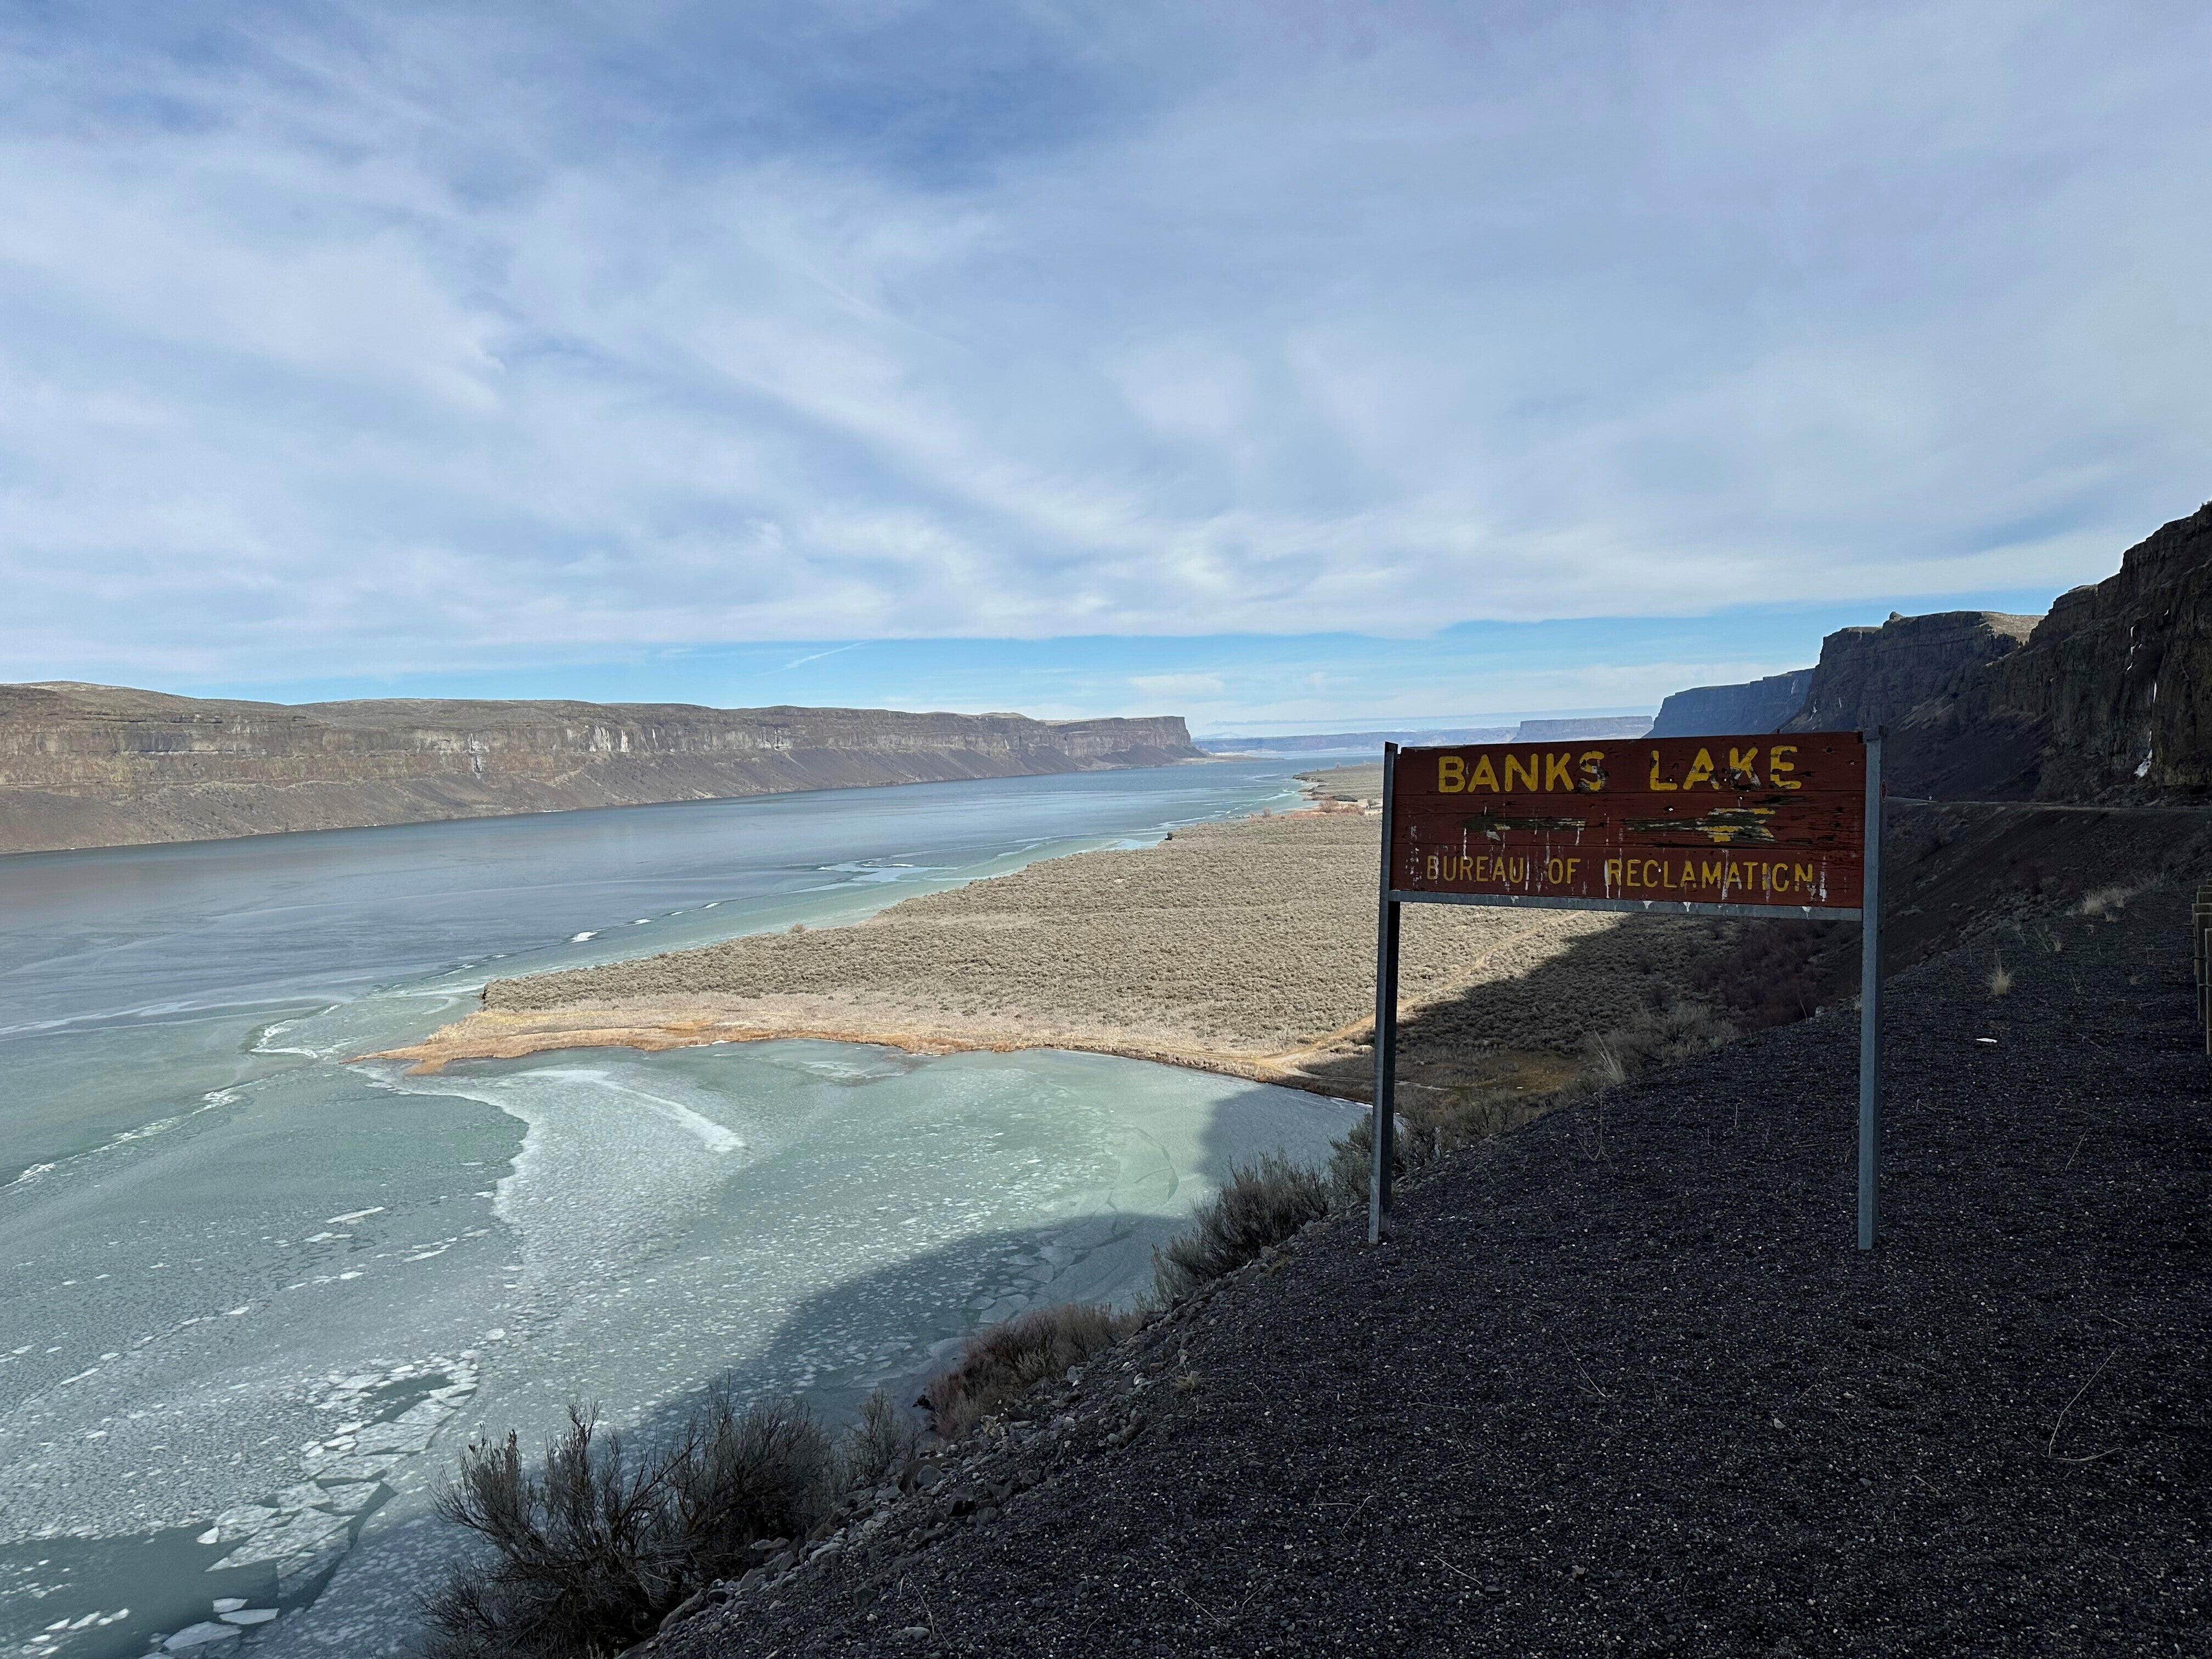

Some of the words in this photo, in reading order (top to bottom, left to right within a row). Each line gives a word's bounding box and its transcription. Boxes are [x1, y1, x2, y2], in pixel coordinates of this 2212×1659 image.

[1438, 751, 1607, 793] BANKS
[1650, 746, 1802, 791] LAKE
[1427, 855, 1523, 883] BUREAU
[1548, 858, 1581, 884] OF
[1608, 859, 1813, 892] RECLAMATION
